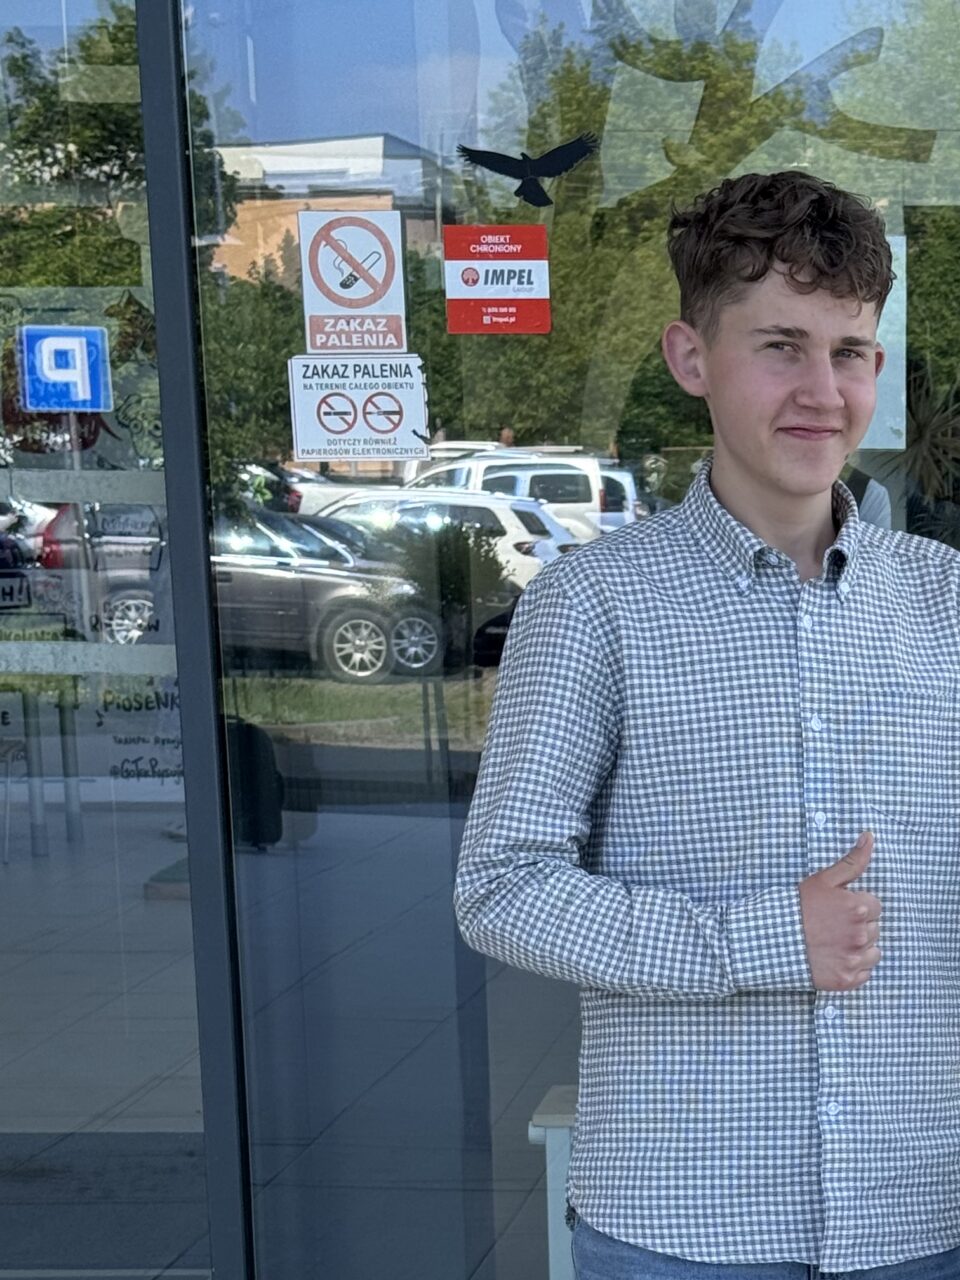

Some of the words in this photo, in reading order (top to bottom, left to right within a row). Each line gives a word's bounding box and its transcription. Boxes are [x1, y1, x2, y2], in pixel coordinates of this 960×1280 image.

[480, 235, 511, 243] OBIEKT
[469, 244, 522, 253] CHRONIONY
[483, 269, 534, 286] IMPEL
[323, 318, 388, 332] ZAKAZ
[315, 333, 398, 347] PALENIA
[302, 364, 349, 379] ZAKAZ
[353, 363, 413, 378] PALENIA
[303, 382, 314, 391] NA
[315, 382, 347, 390] TERENIE
[349, 382, 380, 391] CAŁEGO
[381, 382, 415, 390] OBIEKTU
[327, 438, 360, 446] DOTYCZY
[301, 446, 350, 456] PAPIEROSÓW
[352, 446, 425, 455] ELEKTRONICZNYCH
